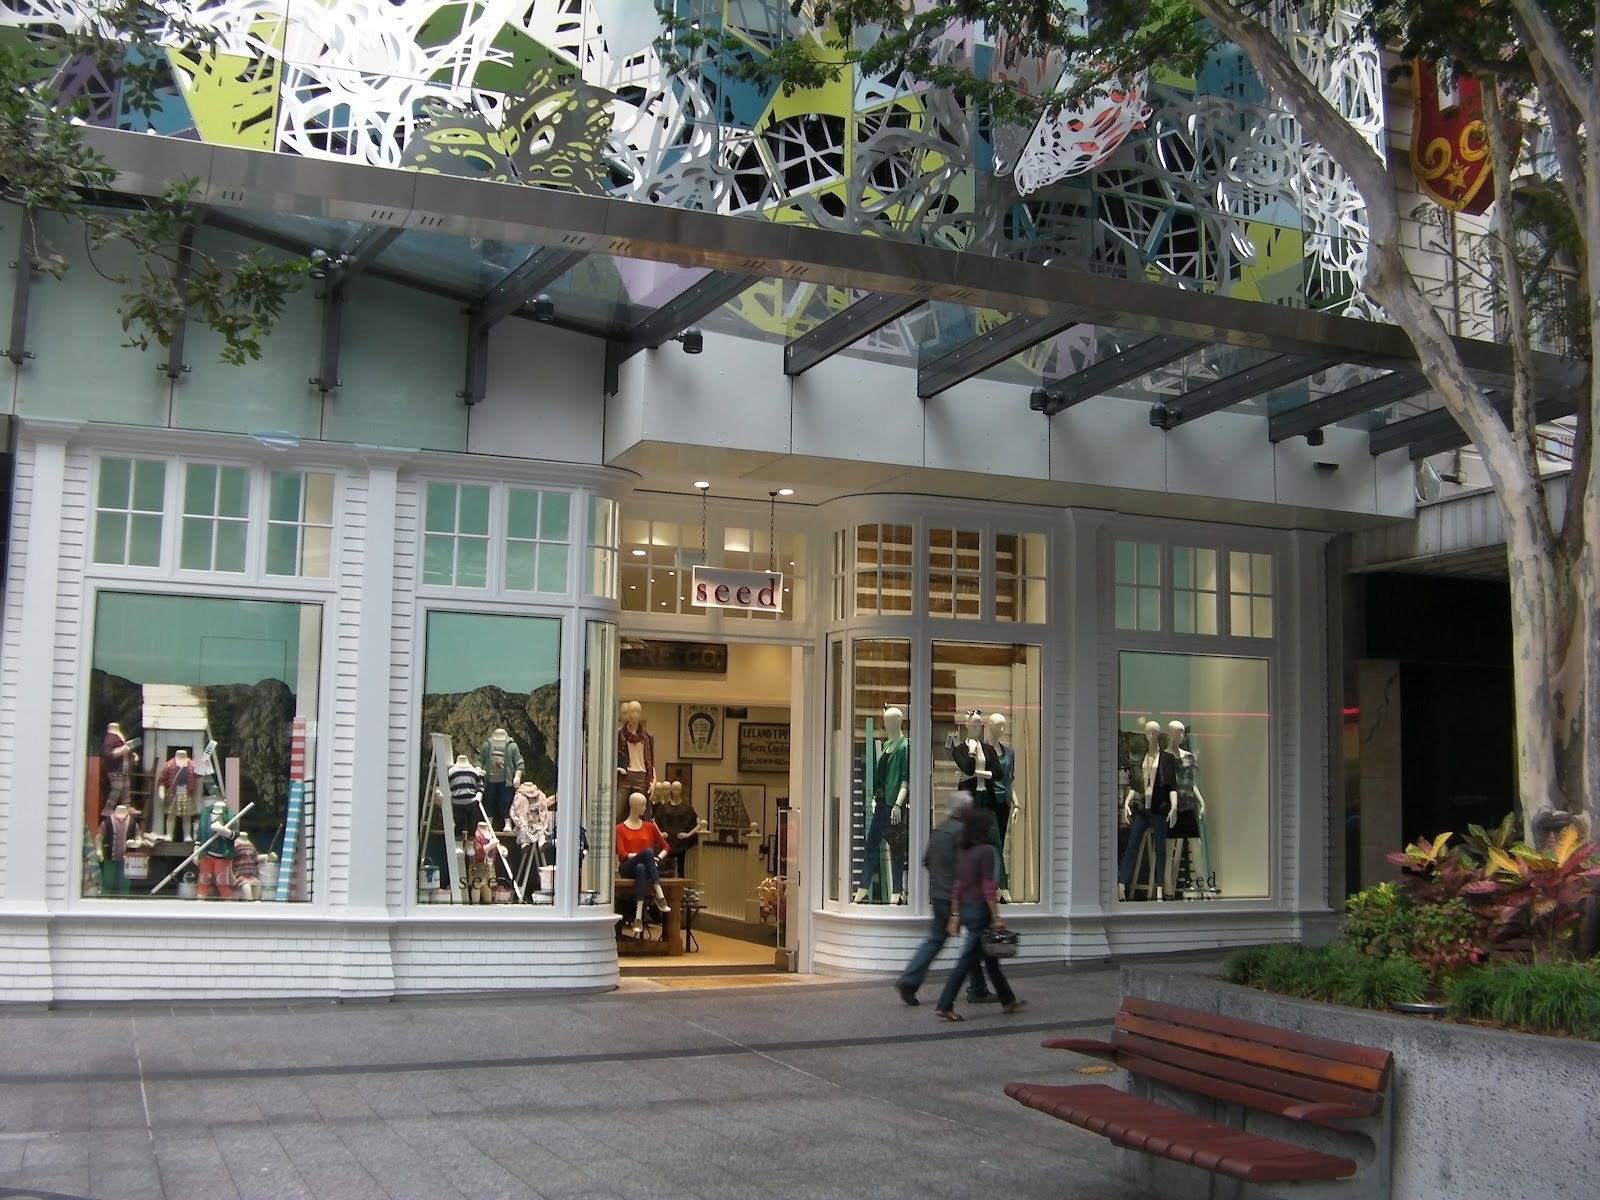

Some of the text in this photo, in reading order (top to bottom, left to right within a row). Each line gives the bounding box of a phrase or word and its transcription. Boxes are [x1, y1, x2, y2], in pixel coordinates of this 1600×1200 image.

[696, 578, 777, 607] seed
[171, 866, 231, 887] eed
[459, 874, 507, 890] see
